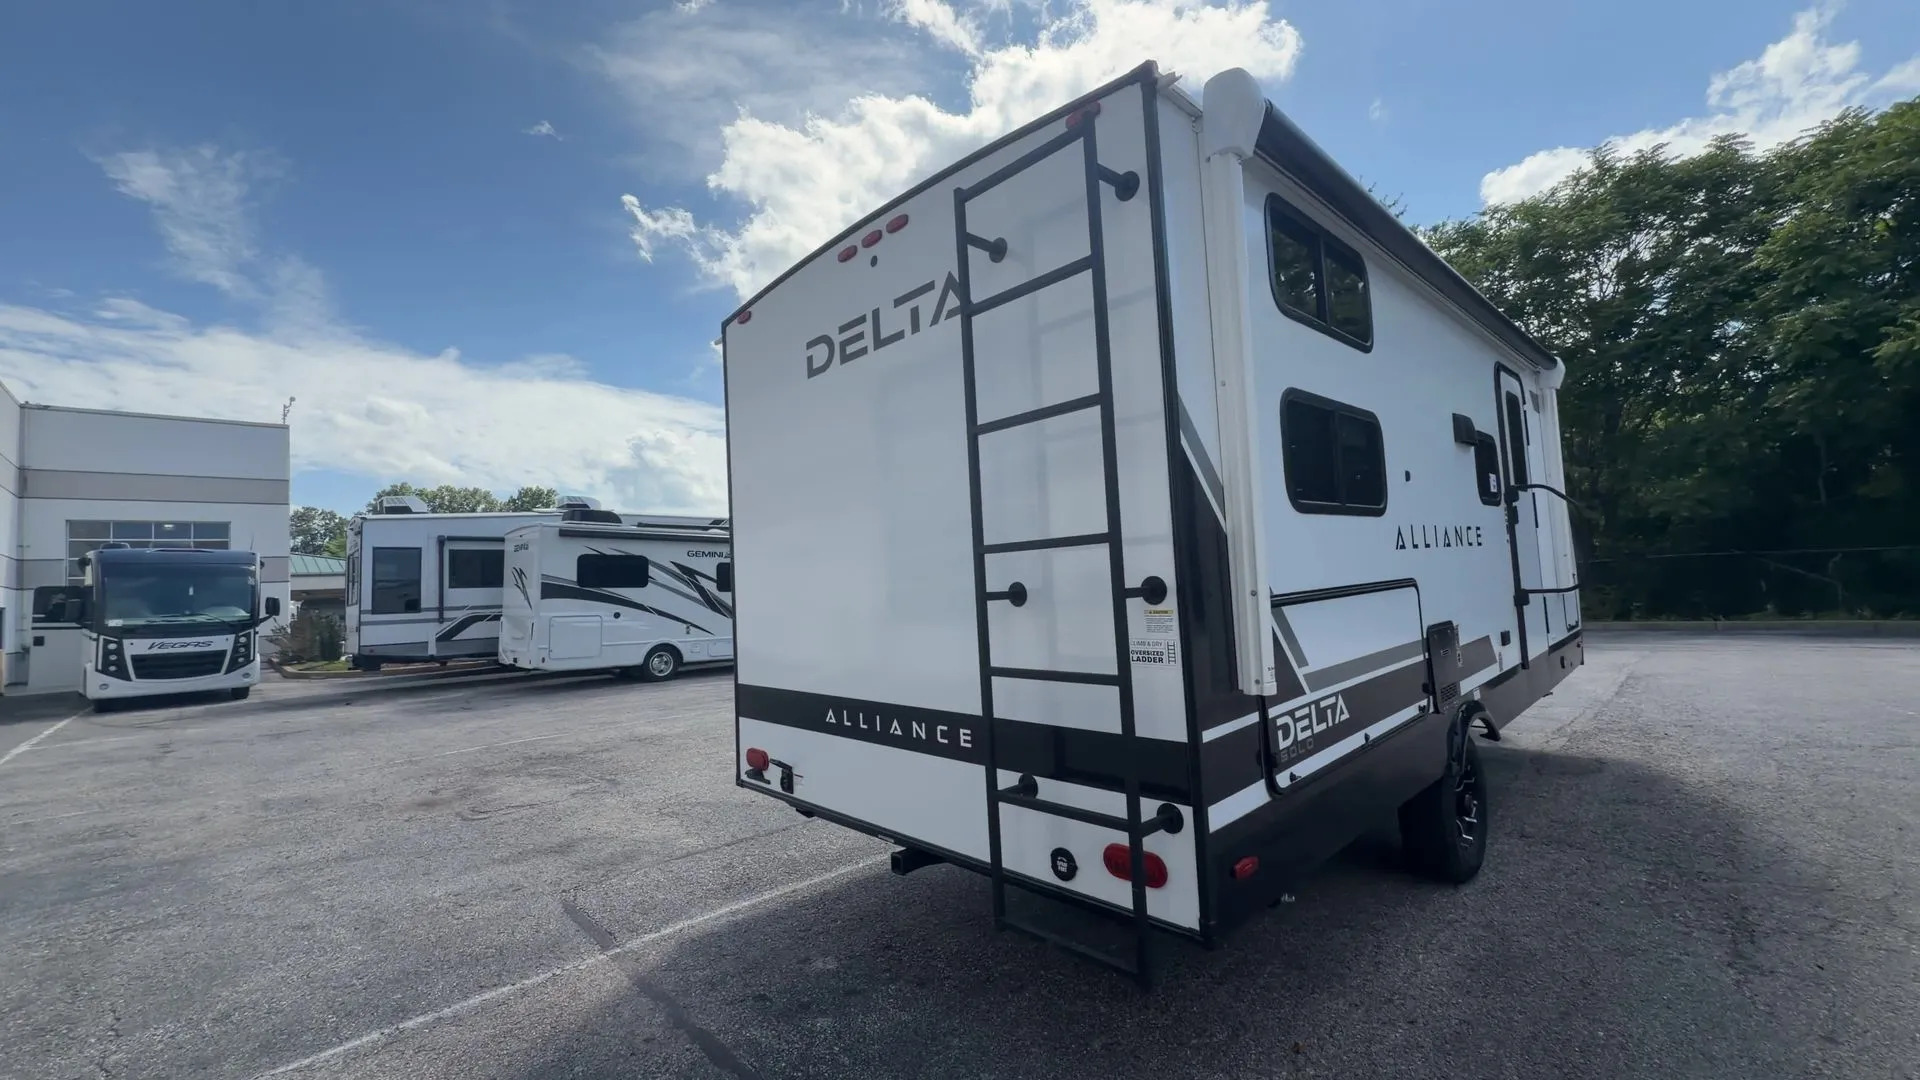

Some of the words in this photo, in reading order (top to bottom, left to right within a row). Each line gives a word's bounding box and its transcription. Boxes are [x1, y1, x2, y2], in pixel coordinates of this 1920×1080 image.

[805, 270, 963, 379] DELTA
[1395, 524, 1483, 550] ALLIANCE
[687, 550, 724, 558] GEMINI
[148, 640, 214, 650] VEGAS
[1132, 656, 1164, 664] LADDER
[825, 708, 972, 748] ALLIANCE
[1276, 693, 1350, 751] DELTA
[1280, 738, 1315, 763] SOLO
